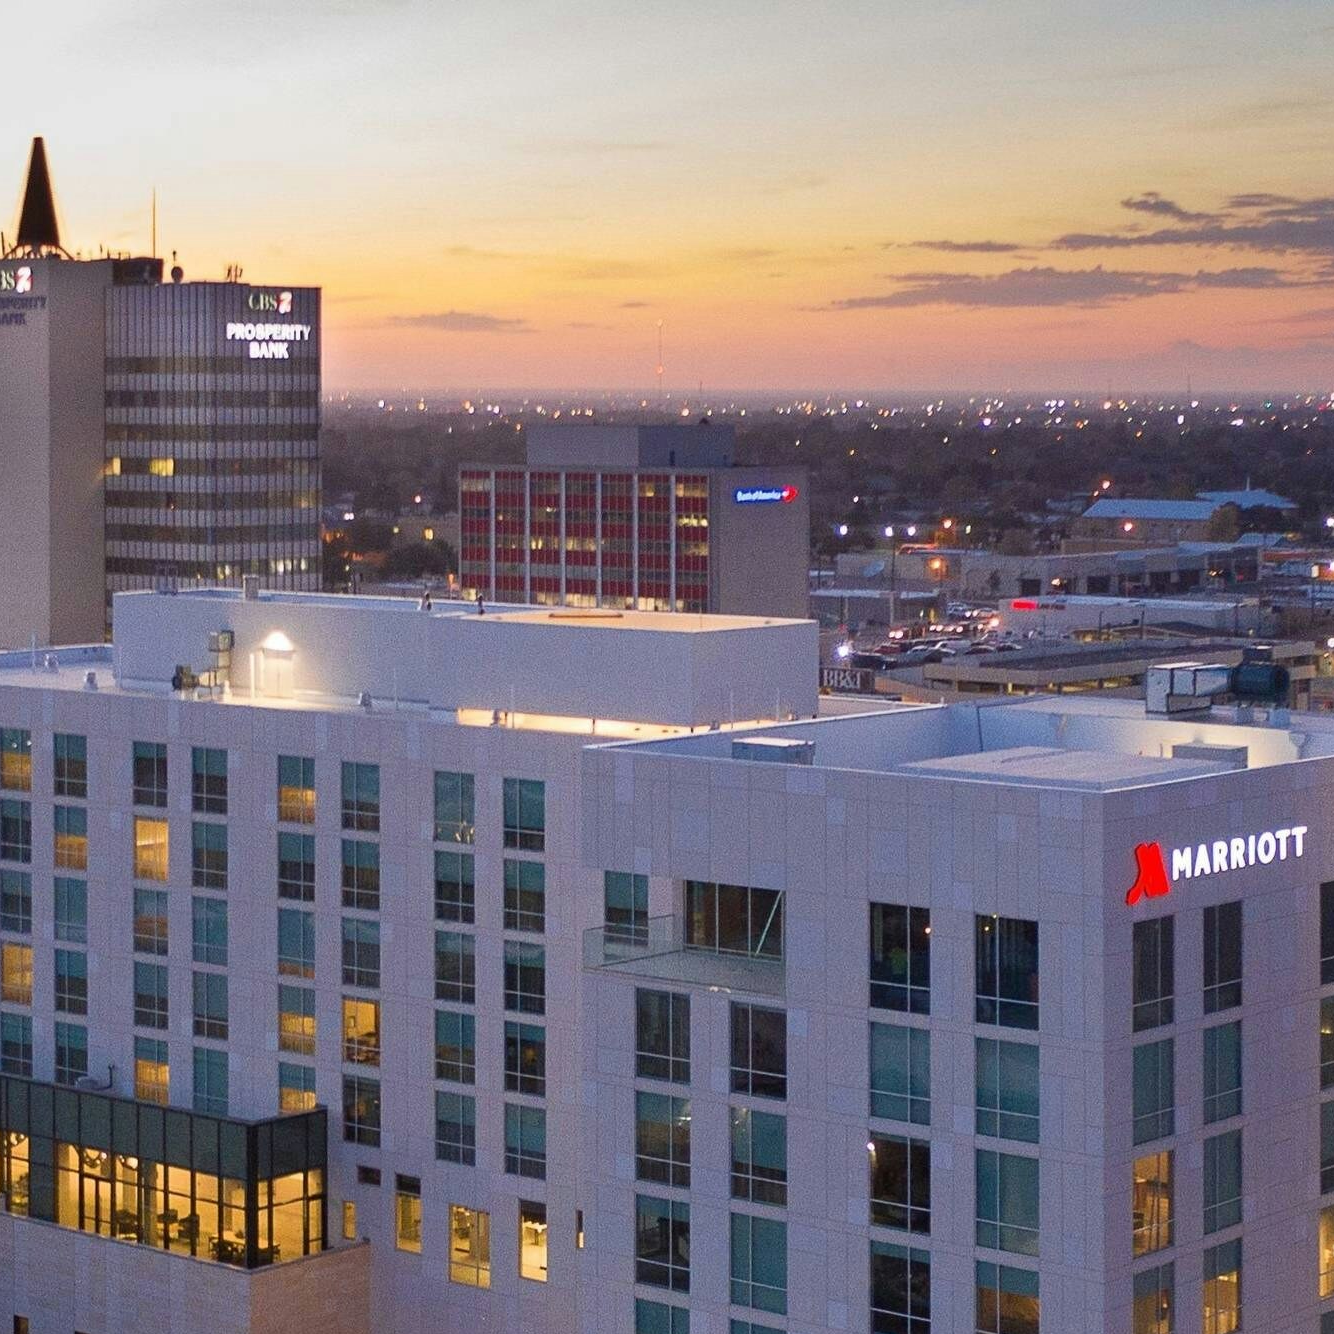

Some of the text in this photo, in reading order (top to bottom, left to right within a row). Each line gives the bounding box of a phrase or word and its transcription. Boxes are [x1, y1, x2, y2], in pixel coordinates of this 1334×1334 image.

[226, 323, 311, 341] PROSPERITY
[249, 341, 289, 359] BANK
[823, 669, 861, 689] BB&T
[1171, 825, 1308, 882] MARRIOTT
